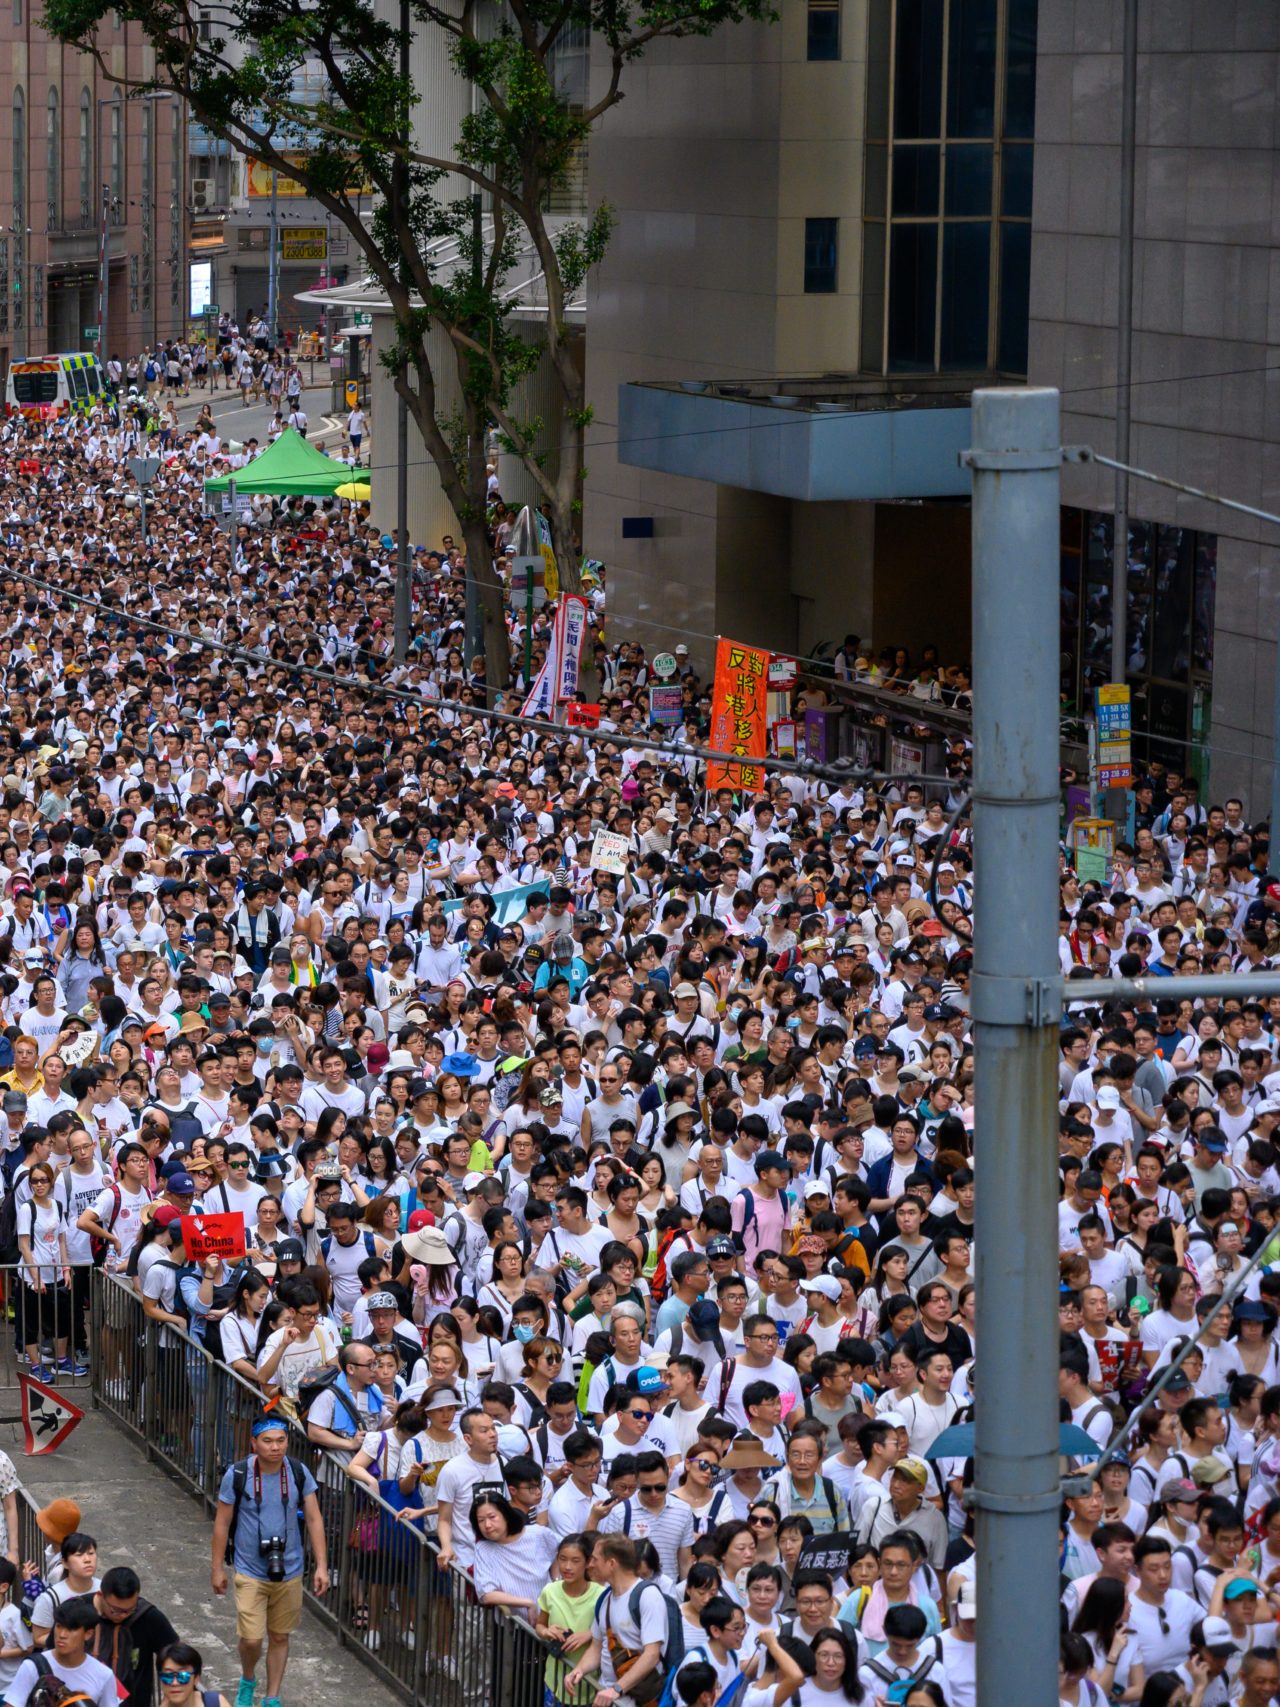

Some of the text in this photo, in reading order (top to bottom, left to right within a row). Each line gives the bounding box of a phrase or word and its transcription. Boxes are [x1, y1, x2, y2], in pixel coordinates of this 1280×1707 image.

[602, 839, 620, 849] RED
[596, 847, 604, 856] I
[318, 1166, 338, 1176] COCO
[190, 1236, 234, 1248] No China
